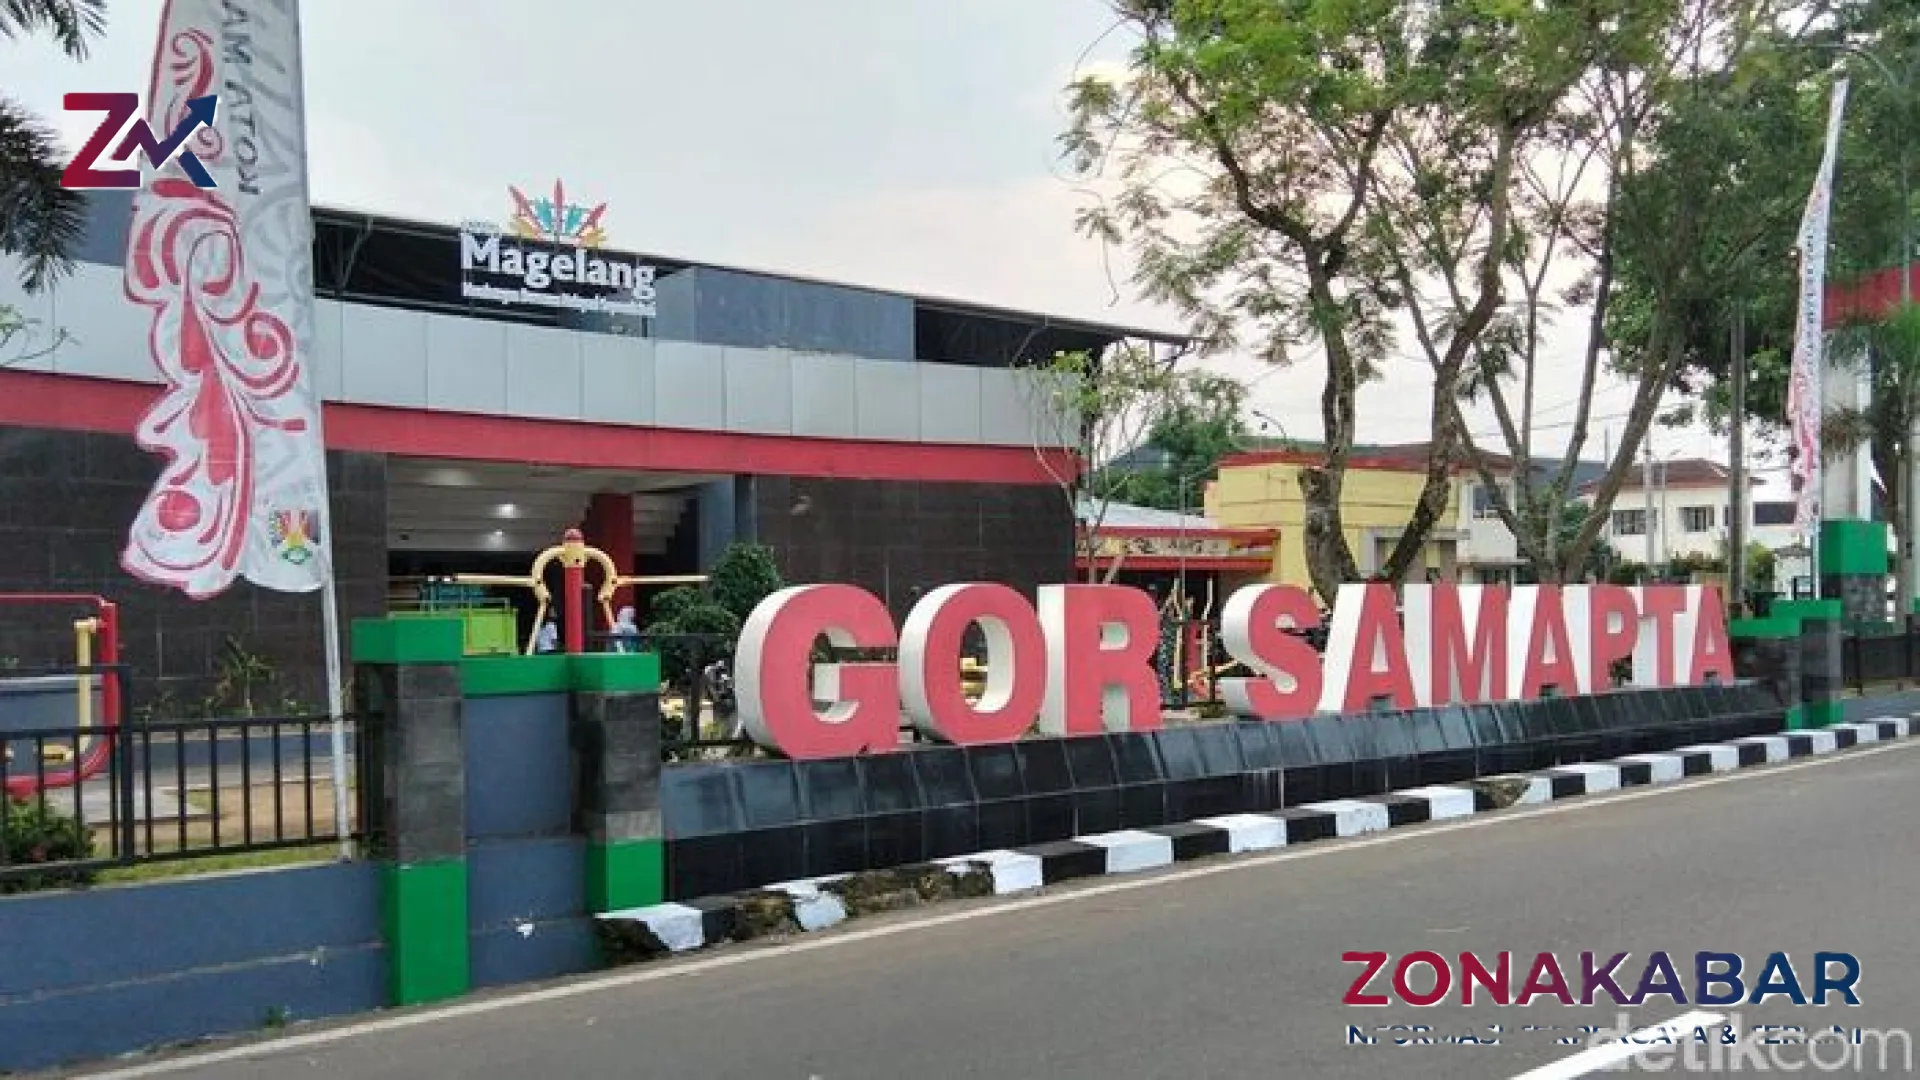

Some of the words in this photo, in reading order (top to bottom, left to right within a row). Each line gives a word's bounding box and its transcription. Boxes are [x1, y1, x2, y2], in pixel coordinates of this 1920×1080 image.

[461, 233, 656, 299] Magelang
[735, 583, 1161, 759] GOR
[1221, 581, 1736, 721] SAMAPTA
